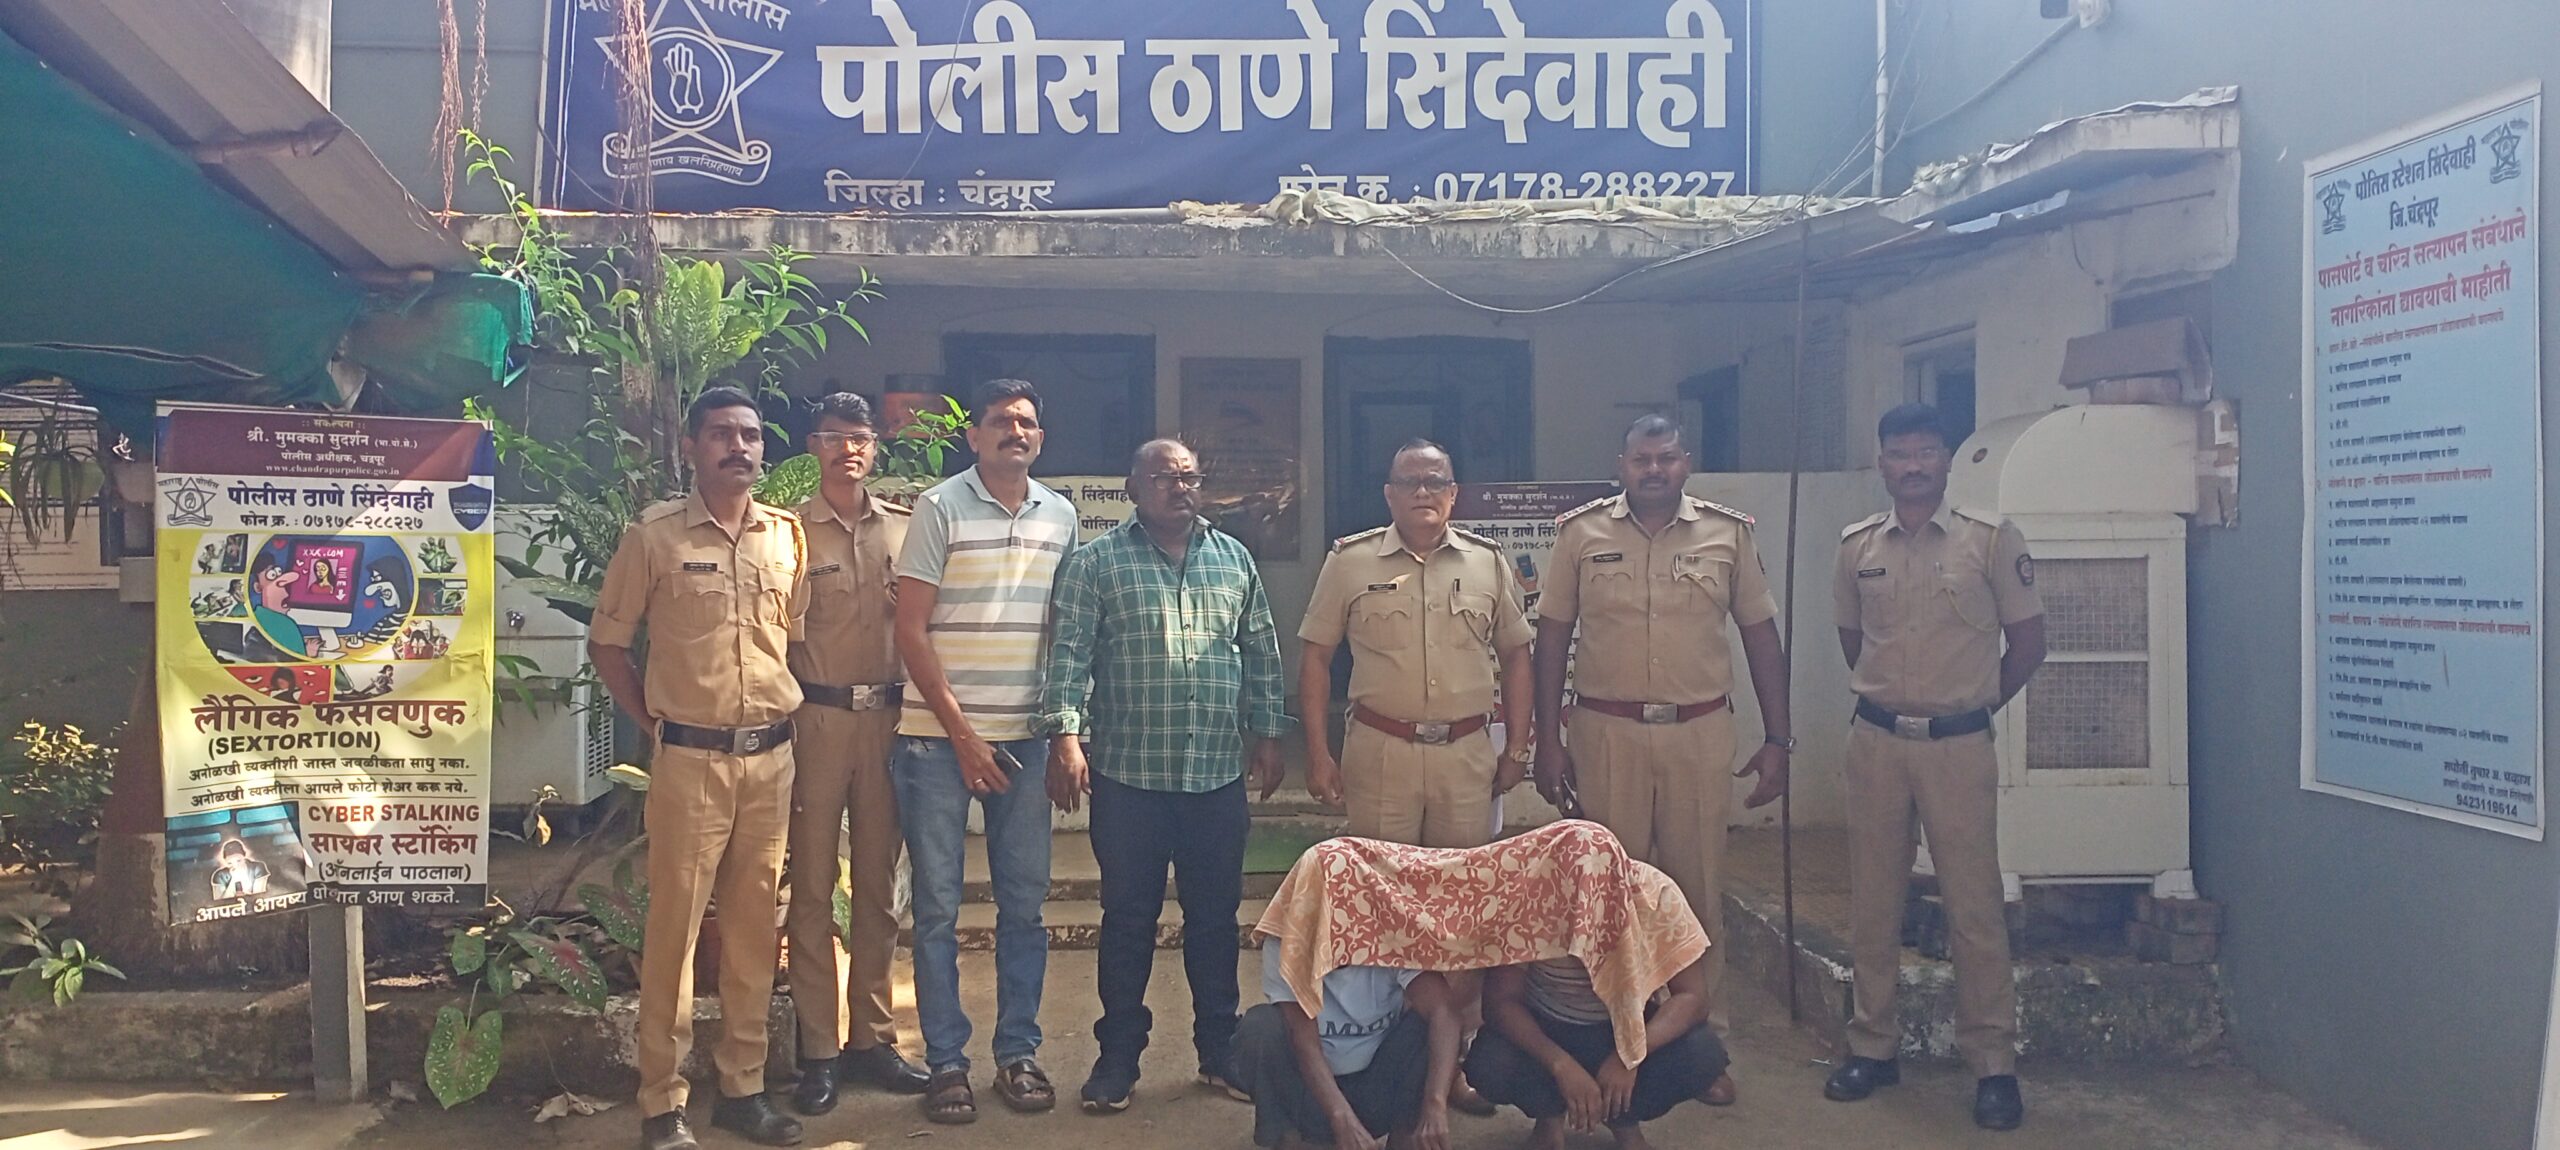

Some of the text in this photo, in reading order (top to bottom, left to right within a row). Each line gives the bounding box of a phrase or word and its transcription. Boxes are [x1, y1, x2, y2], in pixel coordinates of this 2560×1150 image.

[816, 0, 1733, 149] पोलीस ठाणे सिंदेवाही
[2427, 135, 2477, 179] सिंदेवाही
[824, 169, 924, 207] जिल्हा
[957, 169, 1056, 210] चंद्रपूर
[1434, 171, 1736, 201] 07178-288227
[247, 427, 269, 442] श्री.
[275, 431, 324, 448] मुमक्का
[328, 430, 369, 450] सुदर्शन
[281, 449, 312, 461] पोलीस
[265, 464, 400, 476] www.chandrapurpolice.gov.in
[227, 480, 435, 514] पोलीस ठाणे सिंदेवाही
[1081, 484, 1130, 504] सिंदेवाह
[240, 511, 268, 527] फोन
[271, 514, 290, 527] क्र.
[1474, 523, 1509, 538] पोलीस
[1511, 522, 1535, 538] ठाणे
[190, 694, 467, 739] लैंगिक फसवणुक
[208, 731, 381, 760] (SEXTORTION)
[189, 754, 470, 781] अनोळखी व्यक्तीशी जास्त जवळीकता साधु नका.
[191, 786, 244, 807] अनोळखी
[304, 778, 343, 794] आपले
[347, 777, 378, 792] फोटो
[381, 778, 412, 793] शेअर
[444, 778, 468, 793] नये.
[308, 804, 480, 823] CYBER STALKING
[308, 824, 478, 856] सायबर स्टॉकिंग
[400, 863, 471, 883] पाठलाग)
[196, 899, 248, 923] आपले
[411, 886, 460, 904] शकते.
